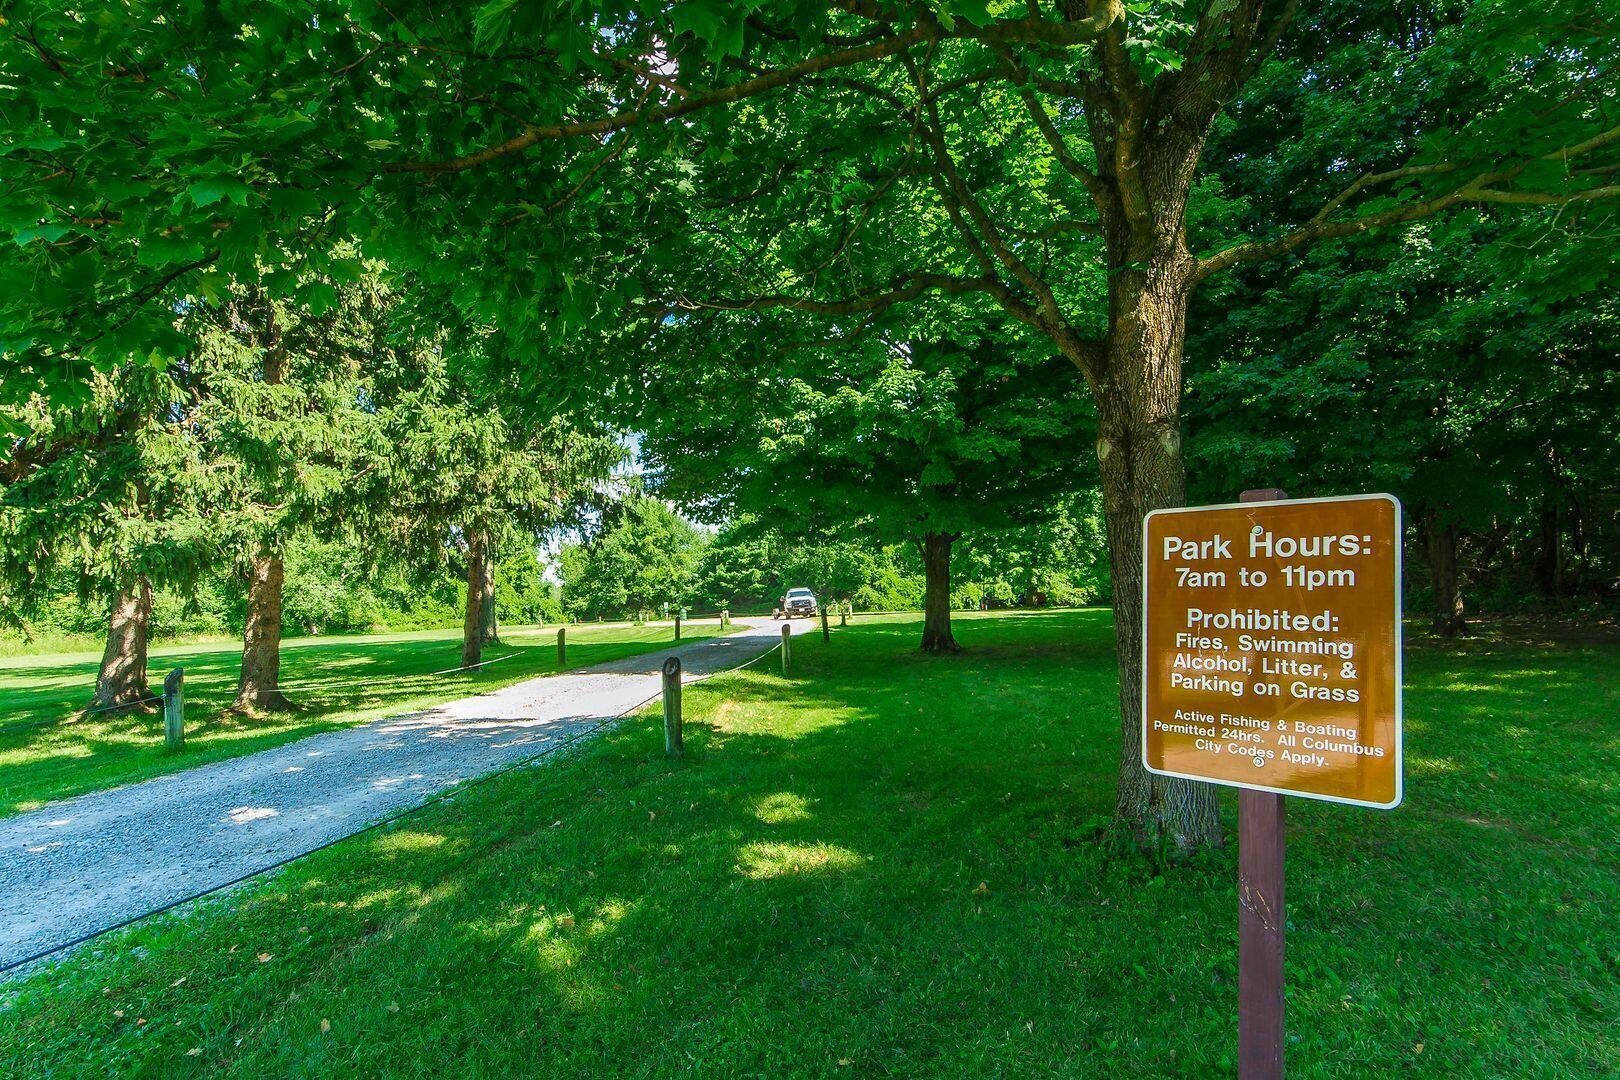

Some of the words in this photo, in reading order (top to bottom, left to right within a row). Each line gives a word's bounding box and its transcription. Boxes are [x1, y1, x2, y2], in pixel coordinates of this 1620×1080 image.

[1163, 534, 1233, 561] Park
[1249, 531, 1371, 558] Hours:
[1175, 567, 1226, 587] 7am
[1239, 568, 1268, 587] to
[1281, 565, 1355, 591] 11pm
[1187, 608, 1339, 632] Prohibited:
[1176, 632, 1229, 653] Fires,
[1238, 634, 1354, 659] Swimming
[1173, 652, 1252, 675] Alcohol,
[1262, 657, 1328, 680] Litter,
[1340, 661, 1358, 680] &
[1171, 673, 1244, 697] Parking
[1253, 682, 1280, 696] on
[1290, 681, 1360, 703] Grass
[1154, 720, 1216, 737] Permitted
[1221, 727, 1265, 744] 24hrs.
[1277, 734, 1296, 747] All
[1302, 736, 1384, 758] Columbus
[1174, 709, 1215, 723] Active
[1220, 713, 1270, 731] Fishing
[1276, 719, 1288, 732] &
[1295, 721, 1357, 740] Boating
[1195, 738, 1222, 754] City
[1227, 743, 1275, 759] Codes
[1280, 750, 1329, 767] Apply.
